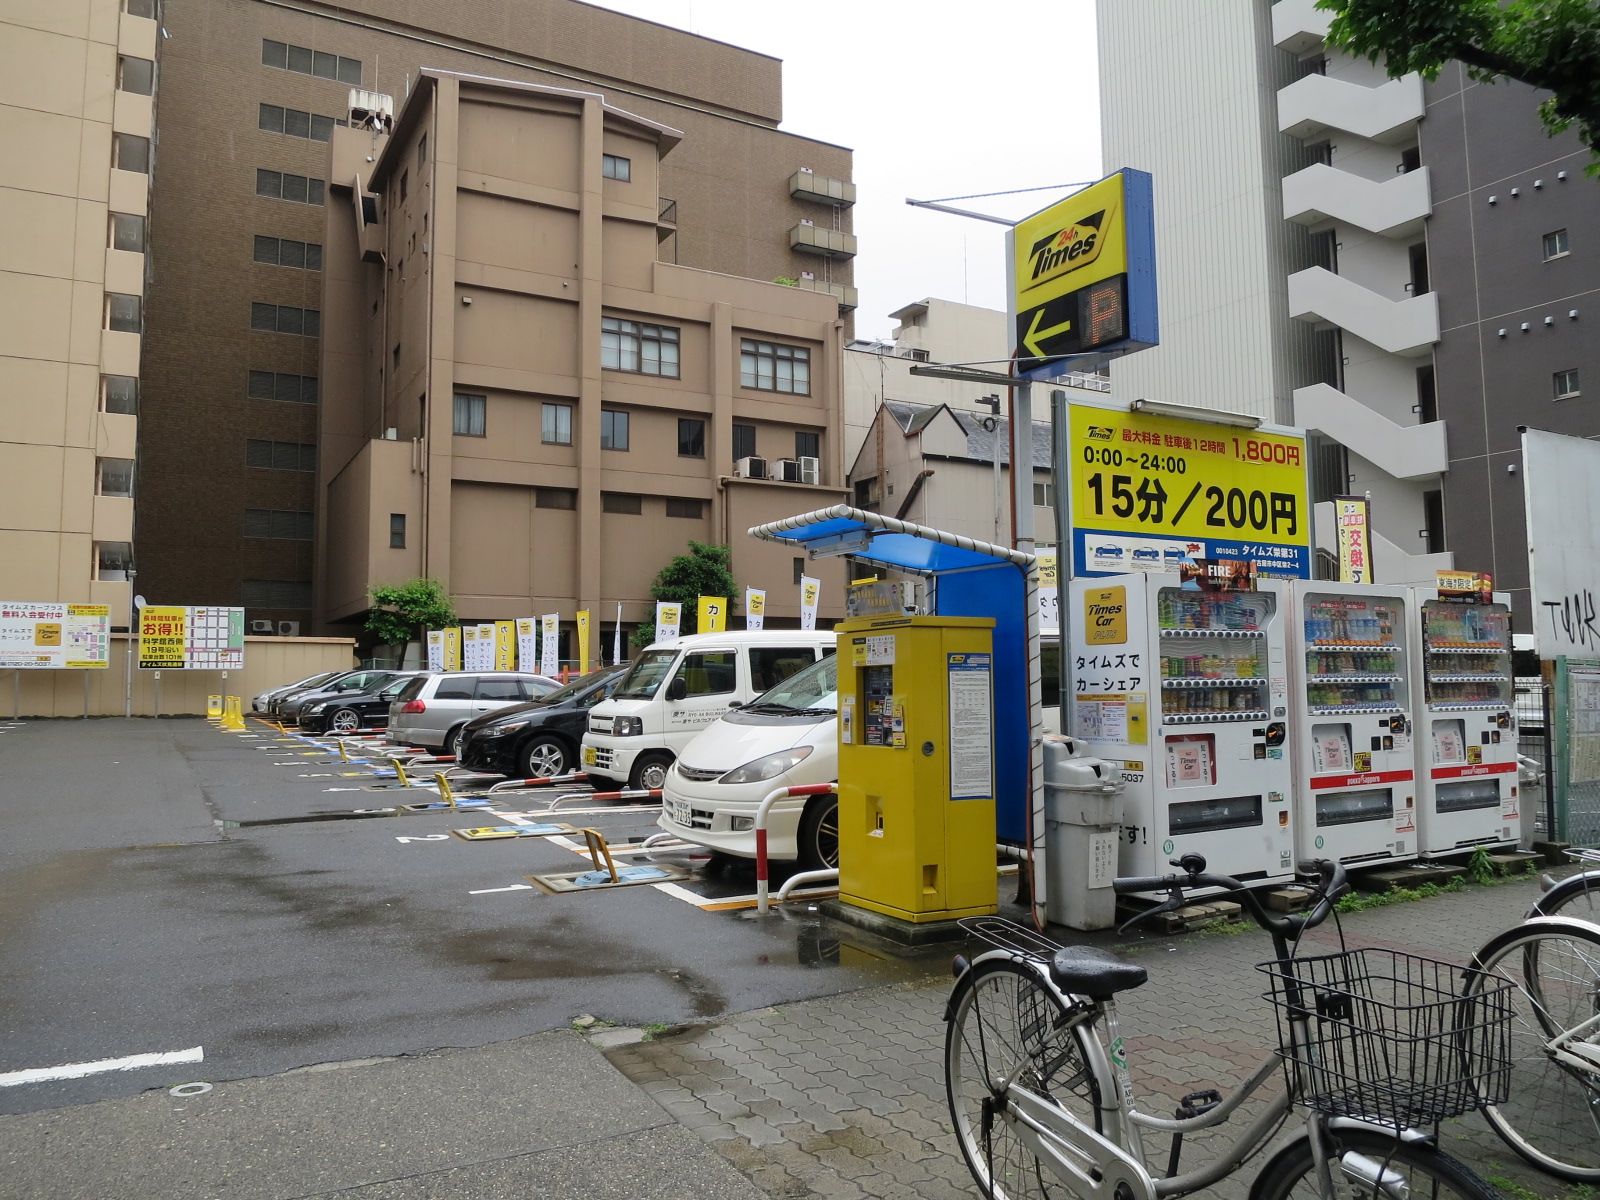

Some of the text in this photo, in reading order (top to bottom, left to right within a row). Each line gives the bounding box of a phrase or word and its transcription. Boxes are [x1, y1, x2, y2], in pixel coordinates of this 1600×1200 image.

[1057, 226, 1079, 247] 24h
[1029, 232, 1097, 280] Times
[1091, 288, 1118, 344] P
[1087, 427, 1112, 440] Times
[1122, 428, 1300, 467] 最大料金 駐車後12時間 1,800円
[1242, 545, 1299, 559] タイムズ栄第31
[1207, 564, 1232, 577] FIRE
[2, 610, 63, 620] 無料入会受付中
[707, 605, 719, 629] カー
[1088, 604, 1122, 616] Times
[1095, 615, 1115, 627] Car
[143, 623, 184, 636] お得!!
[142, 637, 183, 646] 科学館西側
[1076, 654, 1140, 670] タイムズで
[1076, 677, 1141, 692] カーシェア
